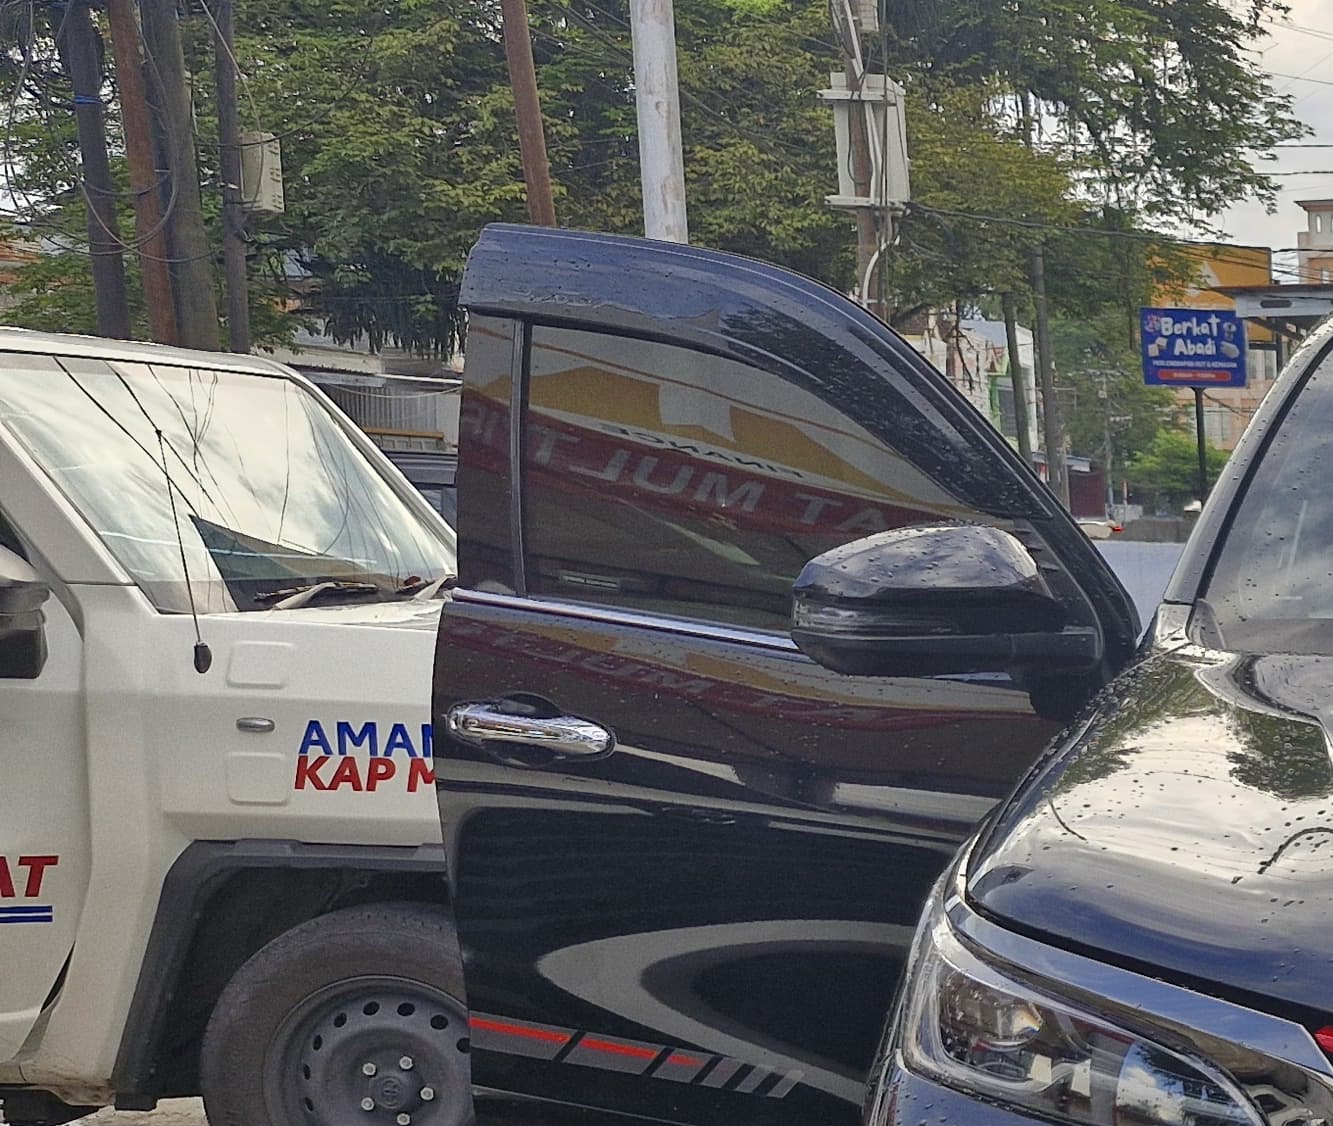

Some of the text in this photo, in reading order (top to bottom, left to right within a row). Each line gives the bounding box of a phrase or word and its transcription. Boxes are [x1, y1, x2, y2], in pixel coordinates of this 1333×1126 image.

[1160, 314, 1221, 336] Berkat
[1174, 338, 1216, 355] Abadi
[294, 755, 396, 792] KAP
